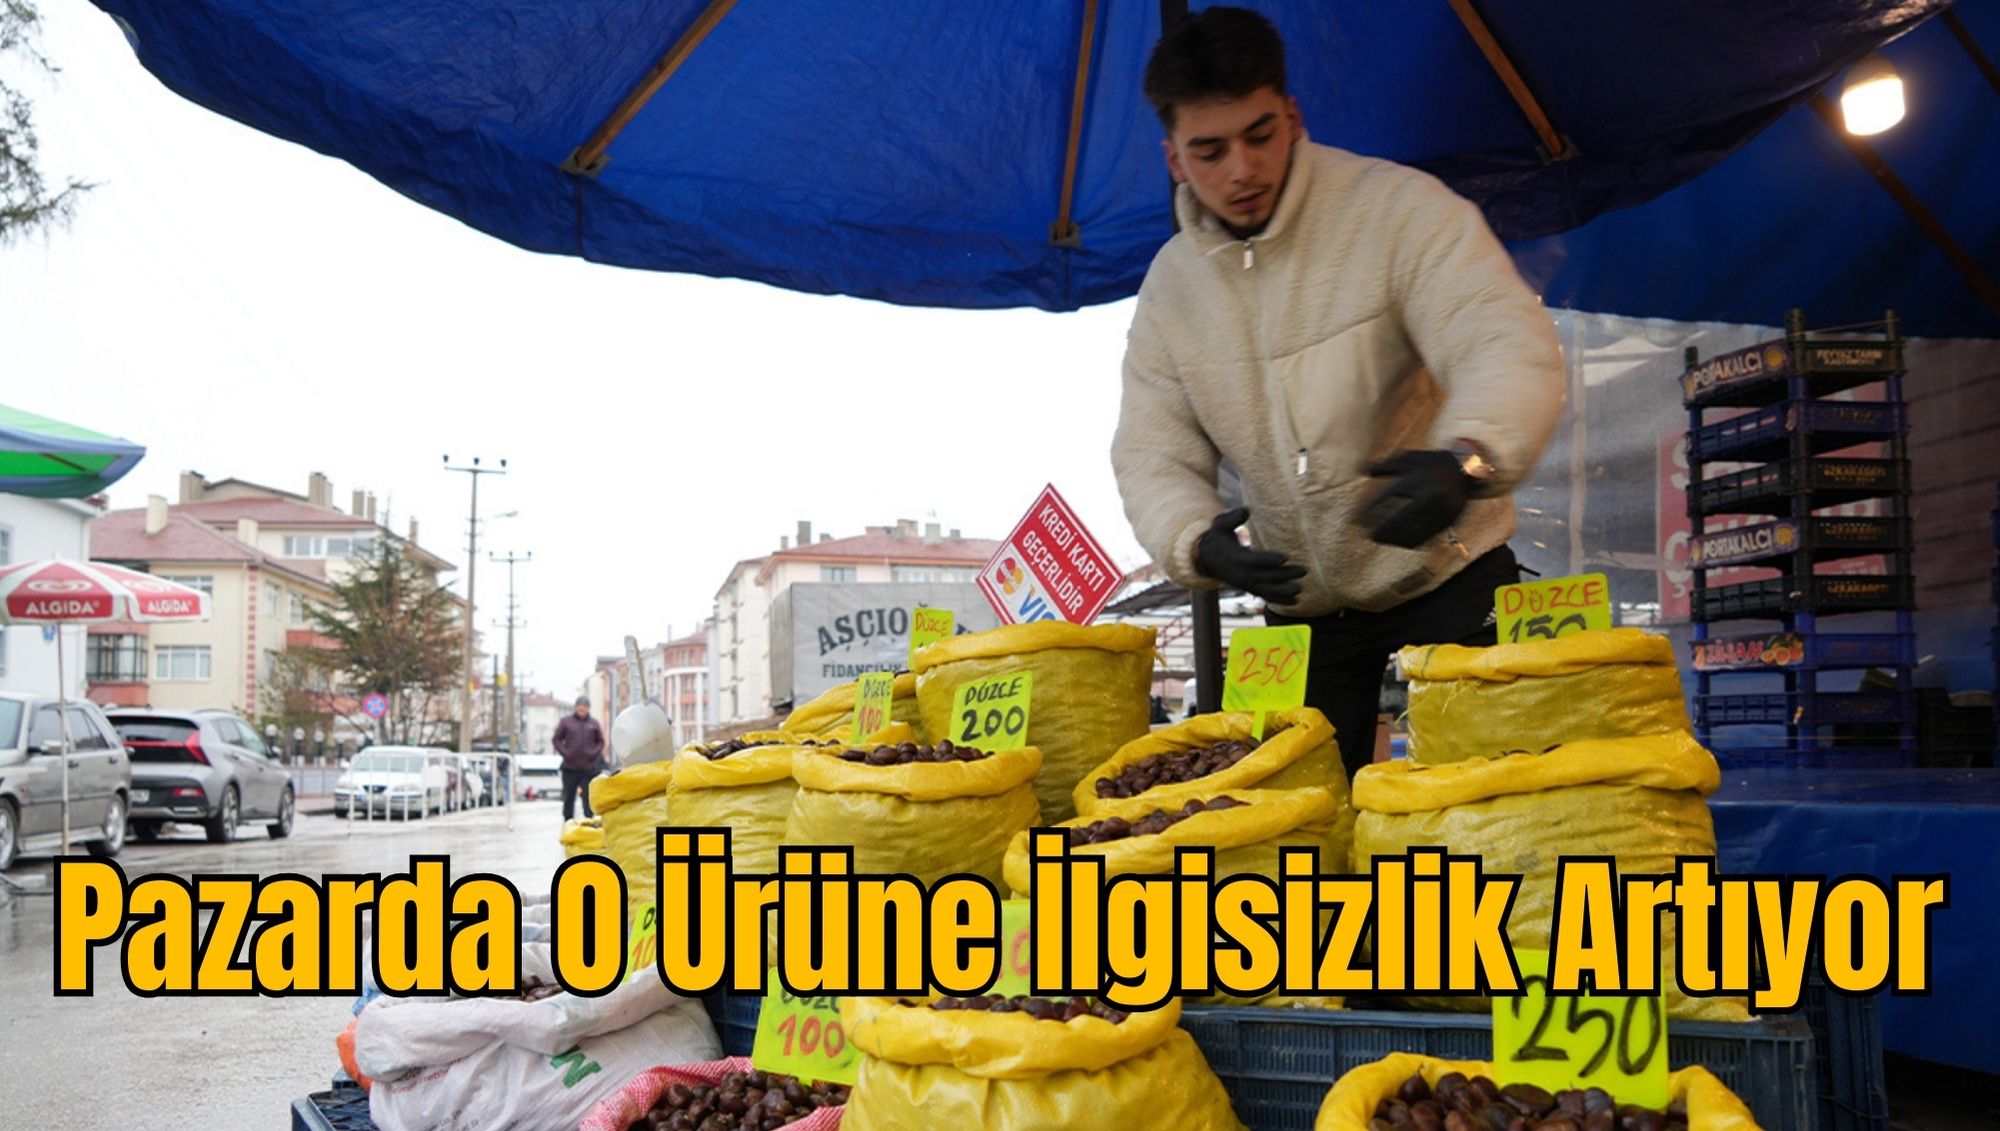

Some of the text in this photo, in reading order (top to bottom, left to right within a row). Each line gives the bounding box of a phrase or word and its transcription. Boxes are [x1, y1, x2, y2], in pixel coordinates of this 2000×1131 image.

[1039, 504, 1106, 592] KREDİ KARTI
[1703, 527, 1772, 560] PORTAKALCI
[1022, 530, 1085, 616] GEÇERLİDİR
[26, 601, 96, 616] ALGIDA
[148, 601, 191, 613] ALGIDA
[1018, 584, 1056, 623] VI
[1504, 581, 1603, 615] DÜZCE
[1238, 647, 1304, 686] 250
[961, 706, 1025, 742] 200
[776, 1013, 845, 1058] 100
[1510, 974, 1662, 1078] 250
